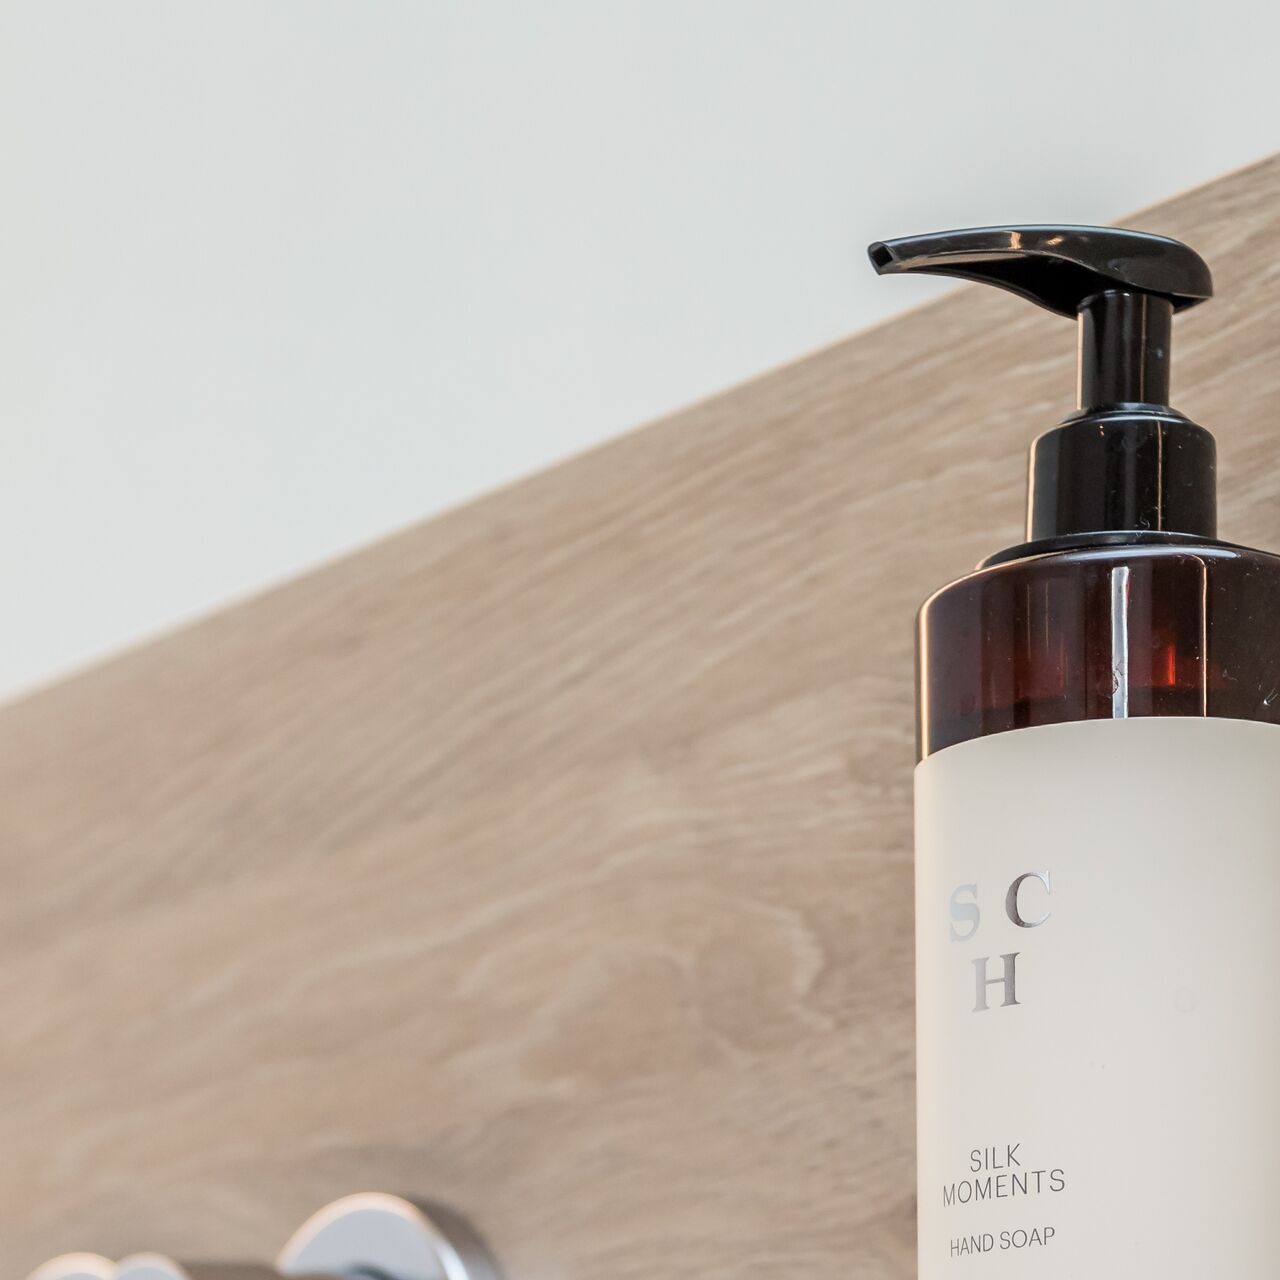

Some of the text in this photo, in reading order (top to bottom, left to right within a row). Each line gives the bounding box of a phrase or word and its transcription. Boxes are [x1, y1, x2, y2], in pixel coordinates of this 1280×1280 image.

[971, 951, 1022, 1013] H
[970, 1142, 1022, 1173] SILK
[943, 1168, 1066, 1208] MOMENTS
[950, 1226, 1056, 1258] HAND SOAP
